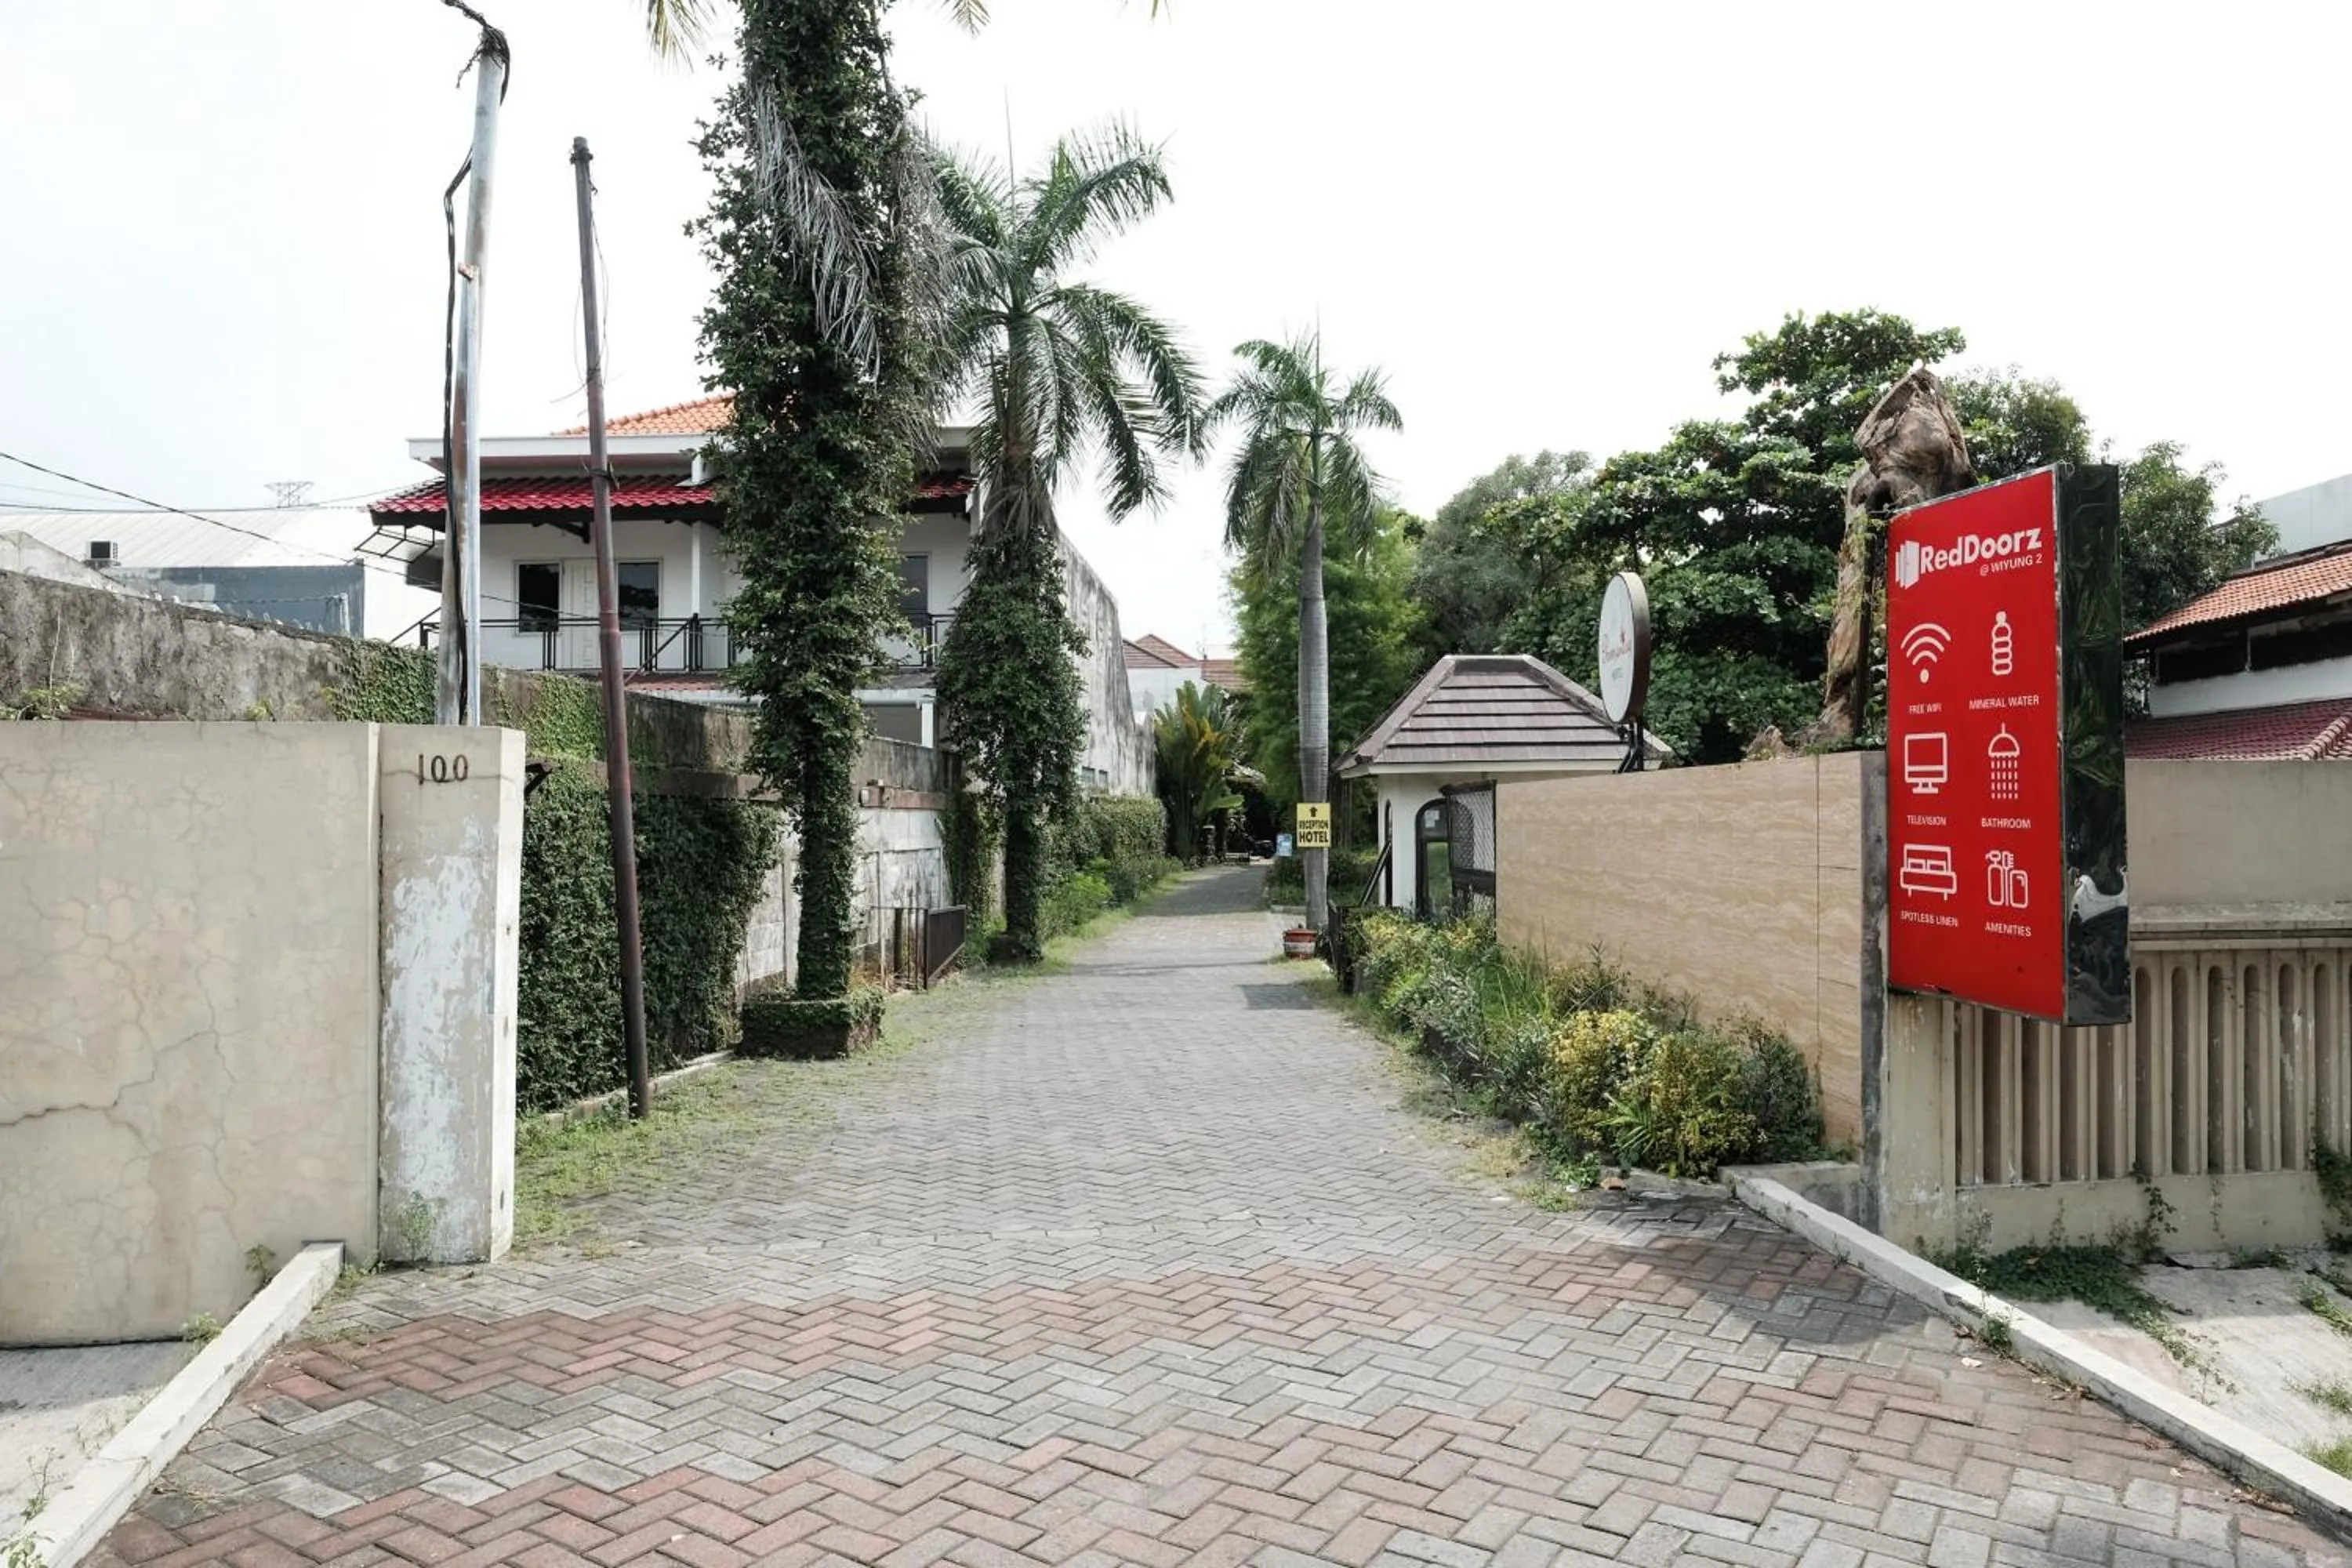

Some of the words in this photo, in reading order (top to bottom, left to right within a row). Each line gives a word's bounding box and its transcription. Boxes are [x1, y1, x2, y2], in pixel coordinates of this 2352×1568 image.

[1920, 528, 2042, 574] RedDoorz
[1980, 564, 1989, 576] @
[1991, 557, 2033, 573] WIYUNG
[2035, 554, 2043, 564] 2
[1909, 704, 1925, 714] FREE
[1926, 702, 1942, 713] WIFI
[1969, 698, 2006, 710] MINERAL
[2008, 695, 2039, 708] WATER
[418, 753, 468, 785] 100
[1298, 819, 1329, 829] RECEPTION
[1907, 815, 1947, 826] TELEVISION
[1981, 817, 2031, 829] BATHROOM
[1299, 830, 1329, 843] HOTEL
[1900, 910, 1935, 925] SPOTLESS
[1936, 914, 1958, 927] LINEN
[1984, 921, 2032, 938] AMENITIES
